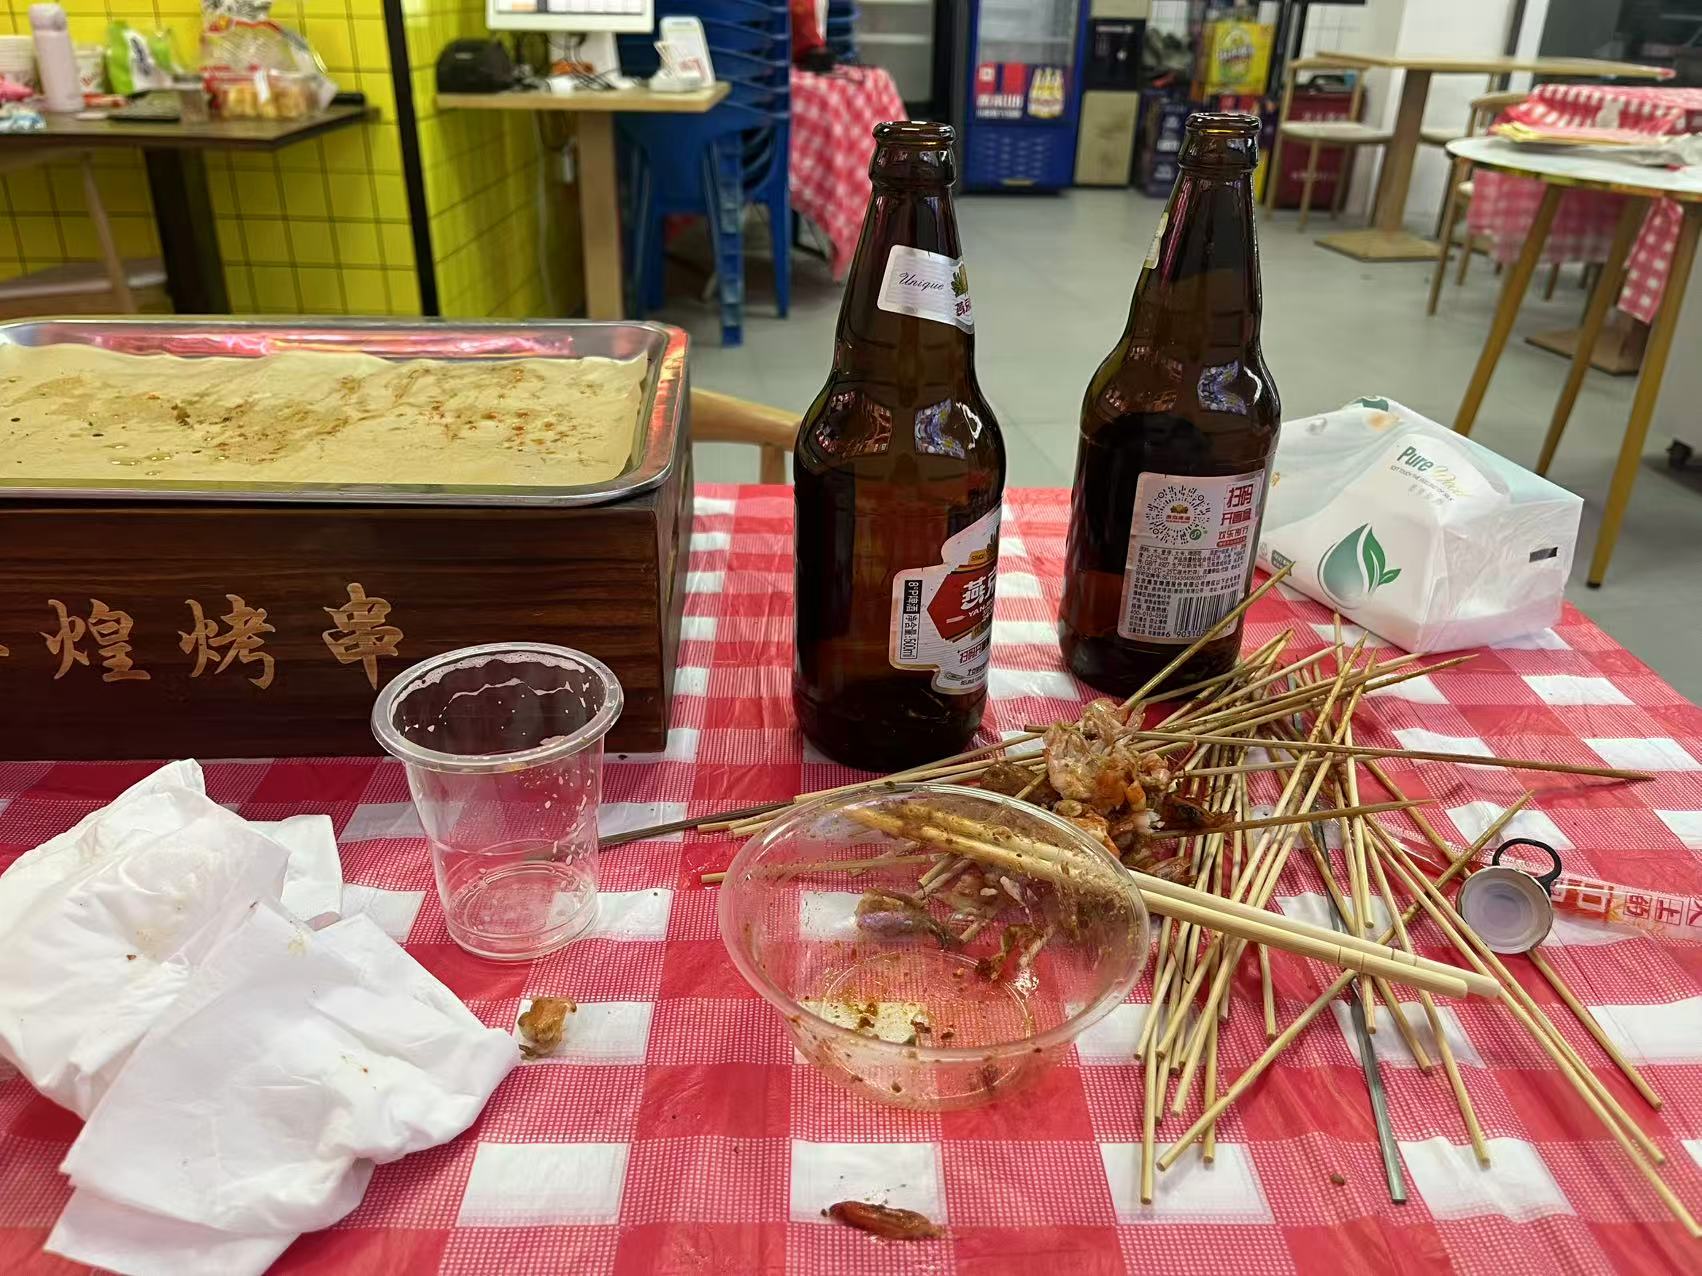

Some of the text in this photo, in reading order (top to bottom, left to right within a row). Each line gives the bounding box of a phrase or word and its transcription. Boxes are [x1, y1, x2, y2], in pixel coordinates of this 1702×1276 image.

[898, 271, 945, 291] Unique
[1396, 445, 1435, 472] Pure
[1227, 483, 1254, 509] 扫码
